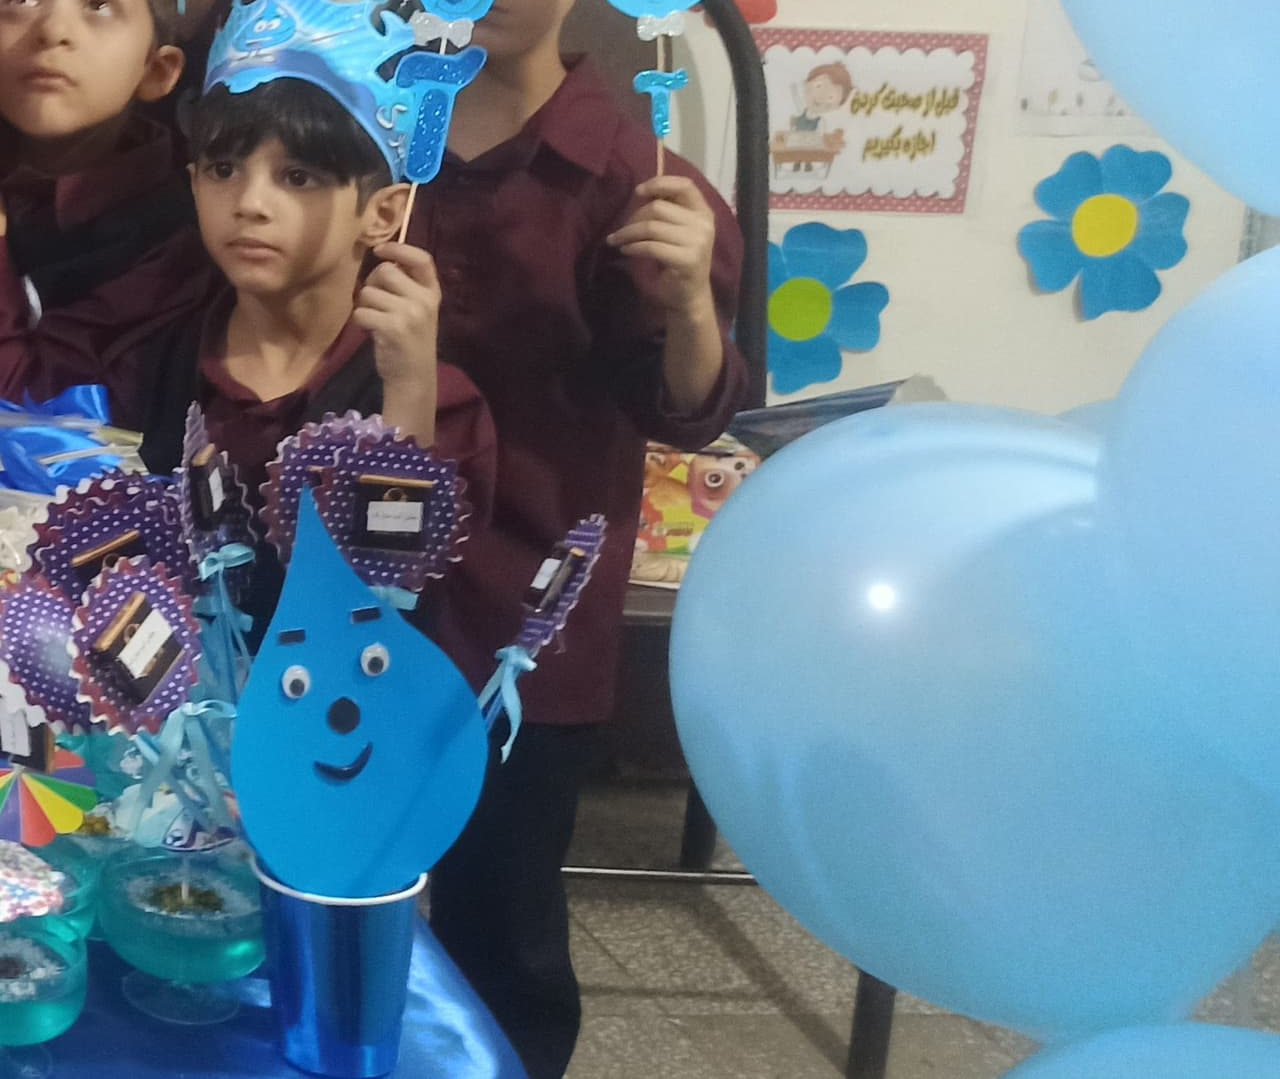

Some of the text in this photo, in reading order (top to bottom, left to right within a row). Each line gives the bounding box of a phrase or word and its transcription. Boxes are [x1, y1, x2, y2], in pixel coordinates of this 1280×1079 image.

[850, 81, 889, 116] کردن
[881, 87, 923, 114] صحبت
[935, 87, 961, 119] قبل
[903, 129, 936, 163] اجازه
